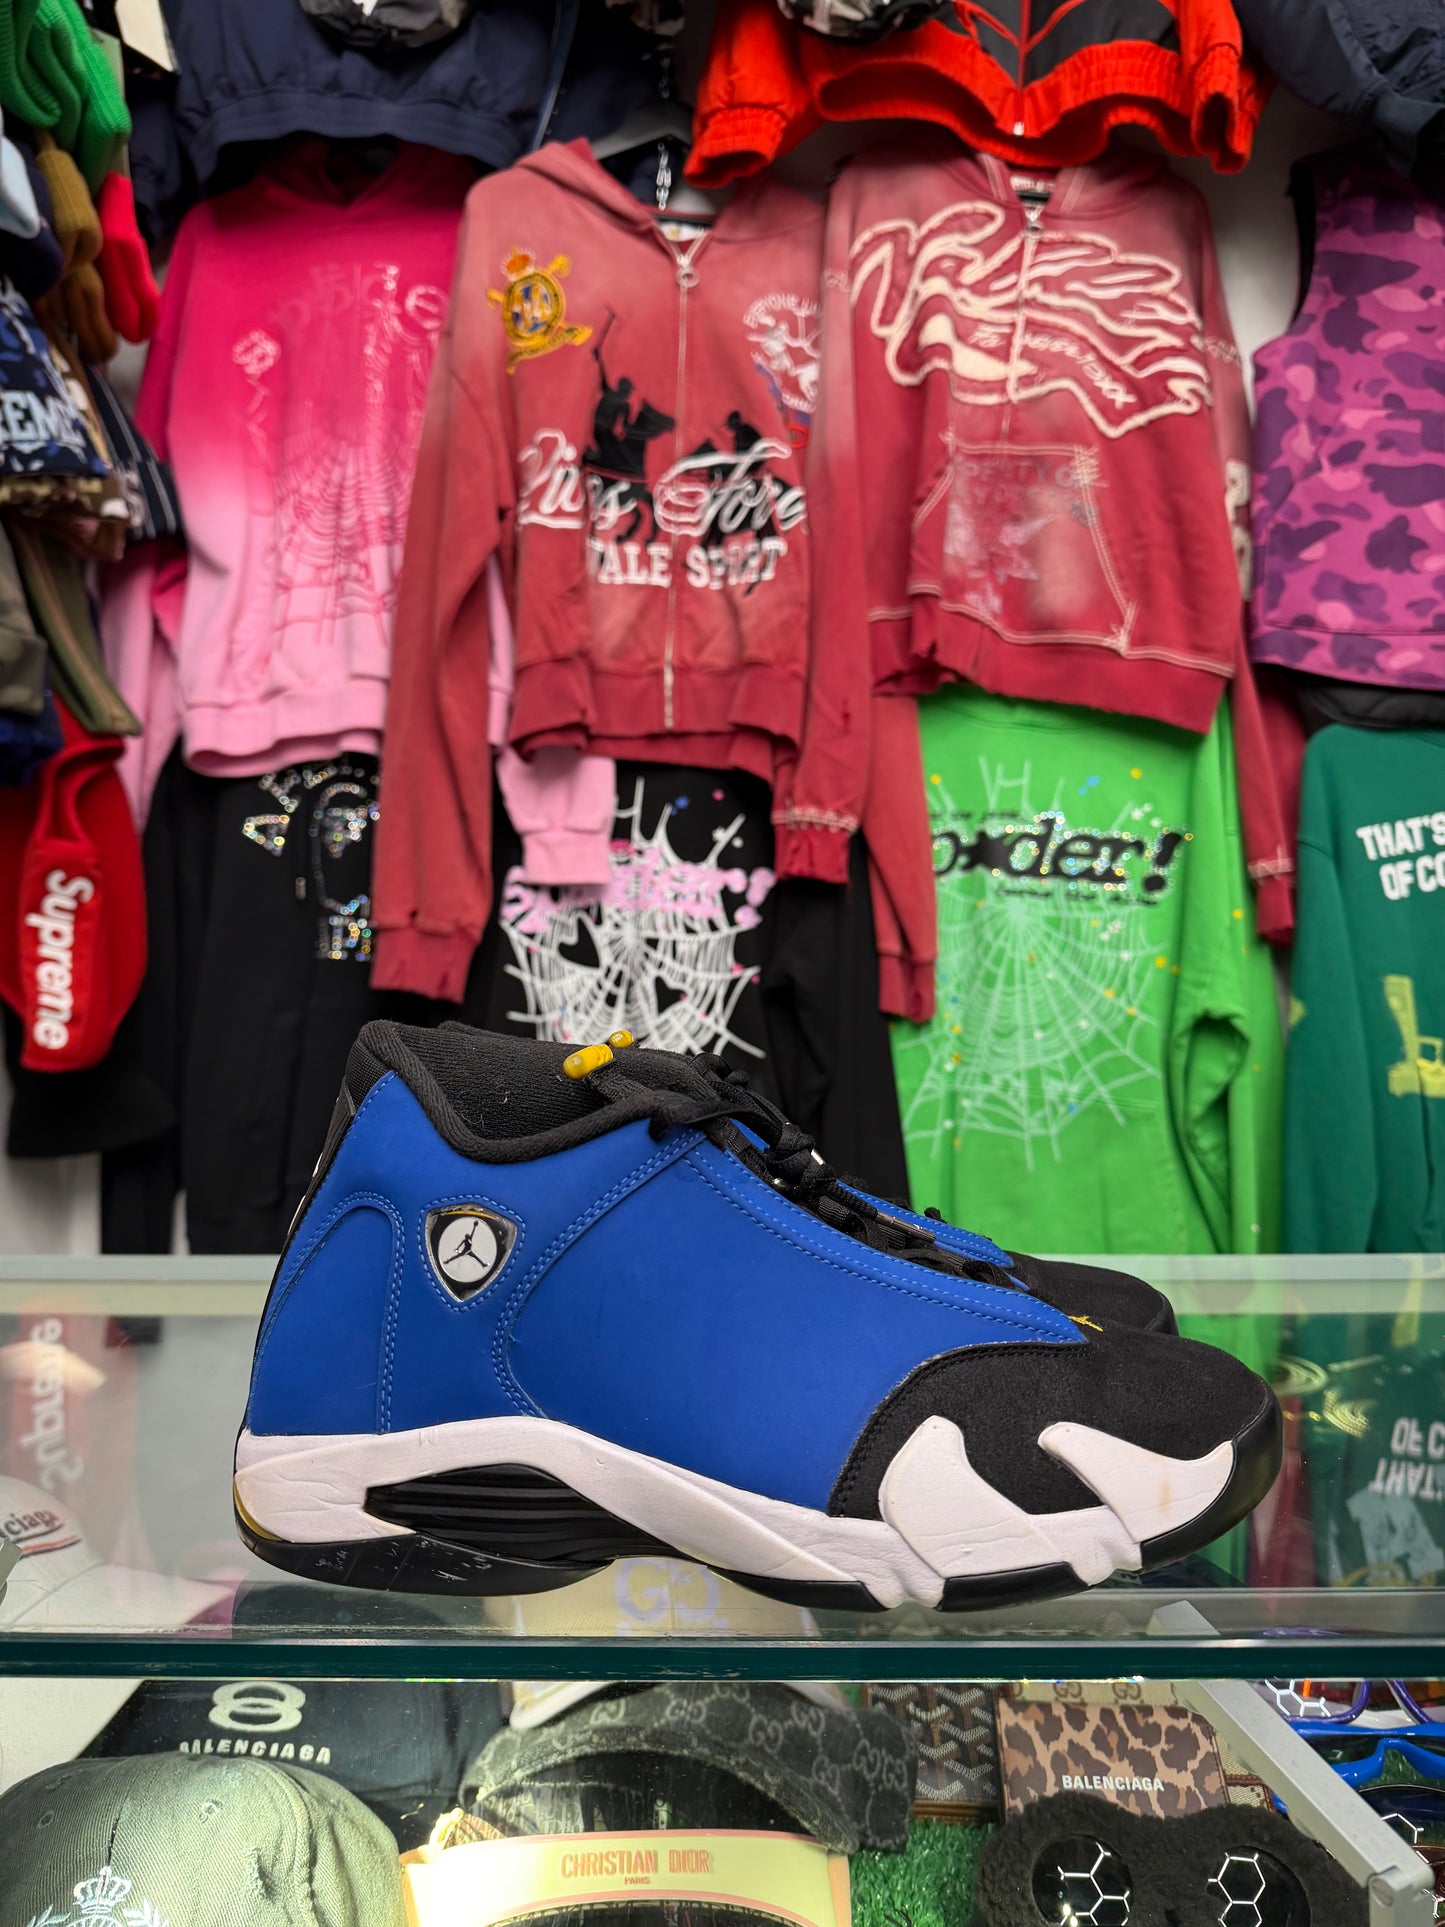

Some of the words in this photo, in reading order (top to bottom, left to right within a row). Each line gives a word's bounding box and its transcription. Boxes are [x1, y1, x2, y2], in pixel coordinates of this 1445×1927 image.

[1378, 859, 1414, 900] OF
[25, 868, 95, 1050] Supreme
[180, 1738, 331, 1765] BALENCIAGA
[1061, 1775, 1164, 1792] BALENCIAGA
[561, 1850, 658, 1879] CHRISTIAN
[668, 1849, 711, 1874] DIOR
[624, 1876, 650, 1885] PARIS
